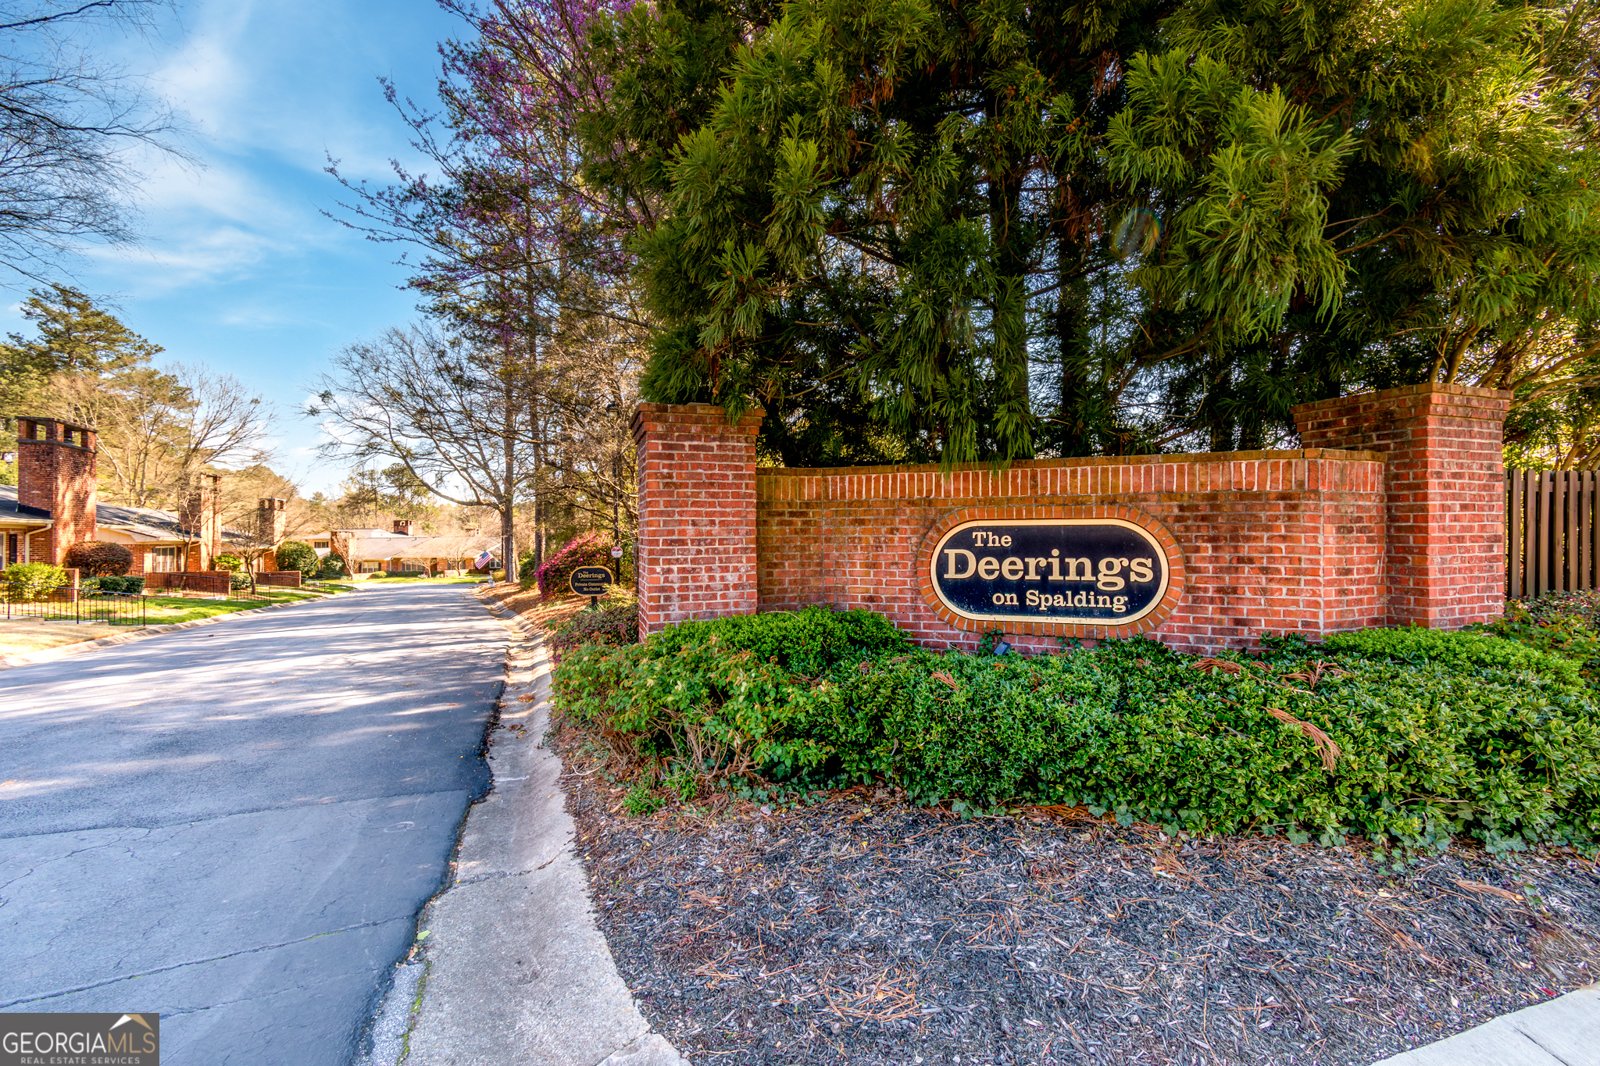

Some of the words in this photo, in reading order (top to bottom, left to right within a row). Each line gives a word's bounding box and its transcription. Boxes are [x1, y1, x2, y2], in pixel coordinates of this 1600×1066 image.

[972, 531, 1012, 547] The
[943, 548, 1154, 591] Deerings
[992, 592, 1019, 606] on
[1025, 589, 1128, 612] Spalding
